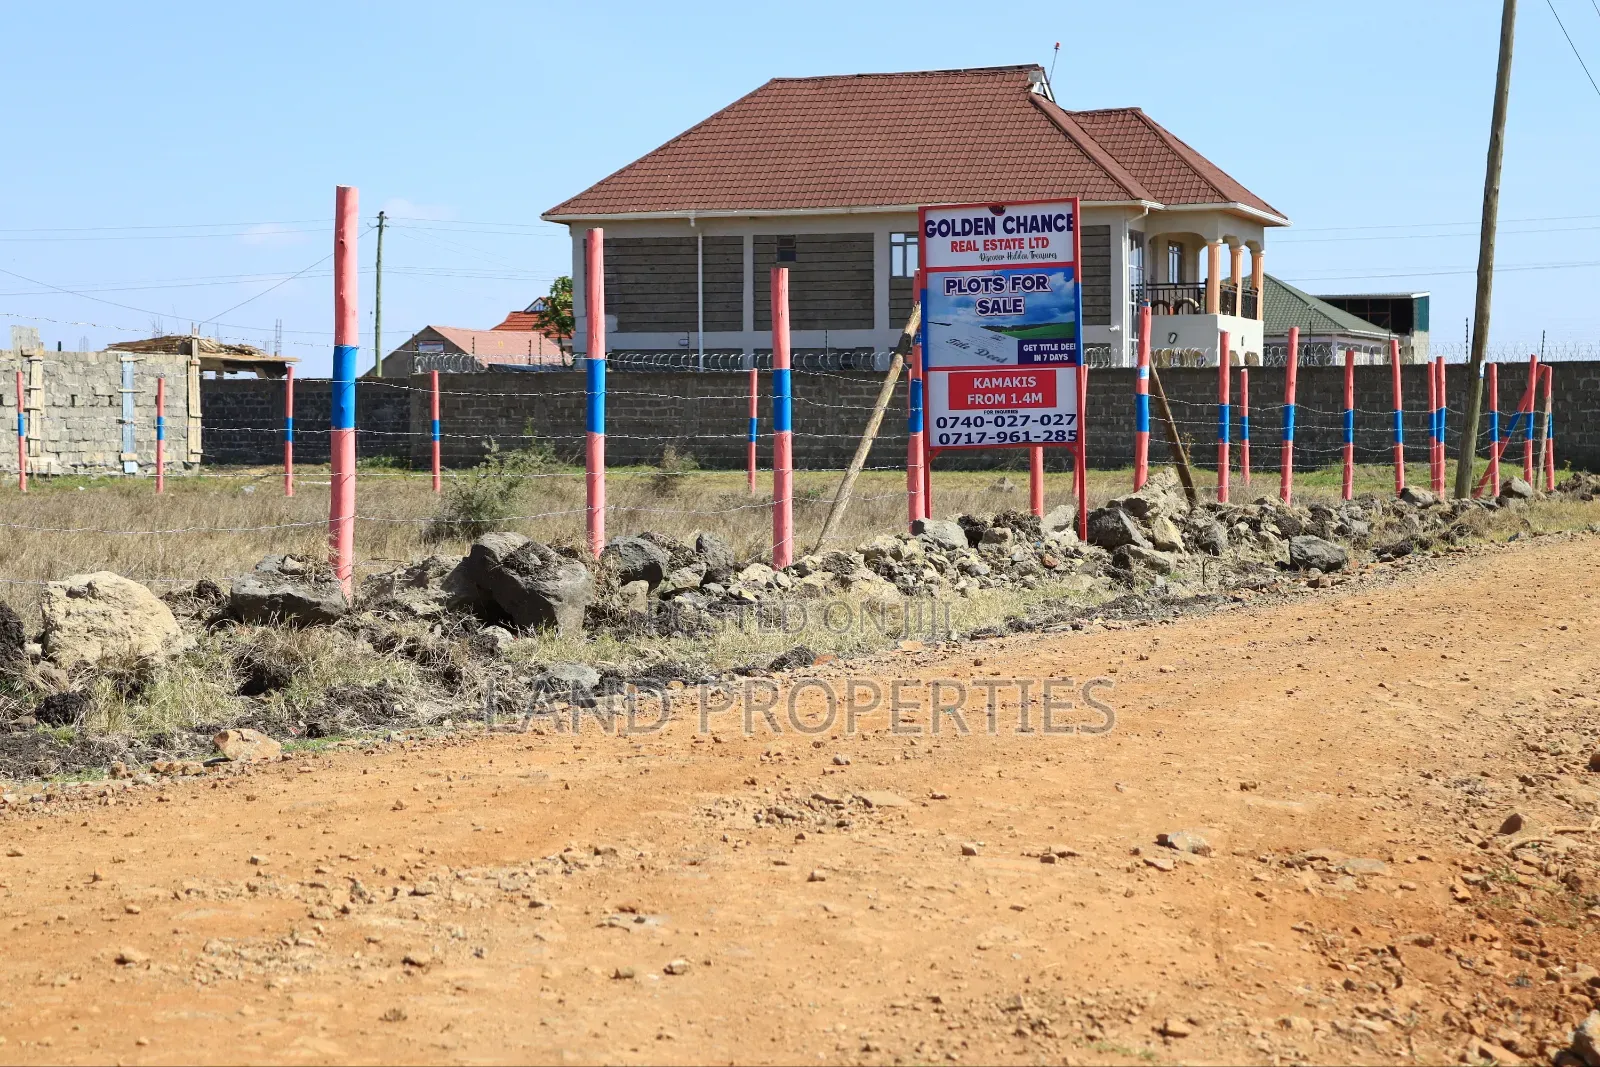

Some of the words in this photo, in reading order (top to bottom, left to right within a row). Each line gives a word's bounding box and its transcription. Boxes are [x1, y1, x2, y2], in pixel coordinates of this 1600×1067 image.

[925, 217, 996, 238] GOLDEN
[1003, 213, 1073, 235] CHANCE
[951, 240, 979, 252] REAL
[983, 238, 1025, 251] ESTATE
[1029, 236, 1050, 249] LTD
[945, 276, 1006, 295] PLOTS
[1010, 274, 1052, 292] FOR
[976, 297, 1025, 315] SALE
[1023, 344, 1038, 352] GET
[1040, 343, 1059, 351] TITLE
[1033, 354, 1042, 362] IN
[1043, 354, 1048, 362] 7
[1049, 353, 1069, 361] DAYS
[973, 376, 1037, 389] KAMAKIS
[967, 394, 1006, 405] FROM
[1010, 392, 1043, 404] 1.4M
[936, 413, 1077, 429] 0740-027-027
[938, 429, 1078, 445] 0717-961-285
